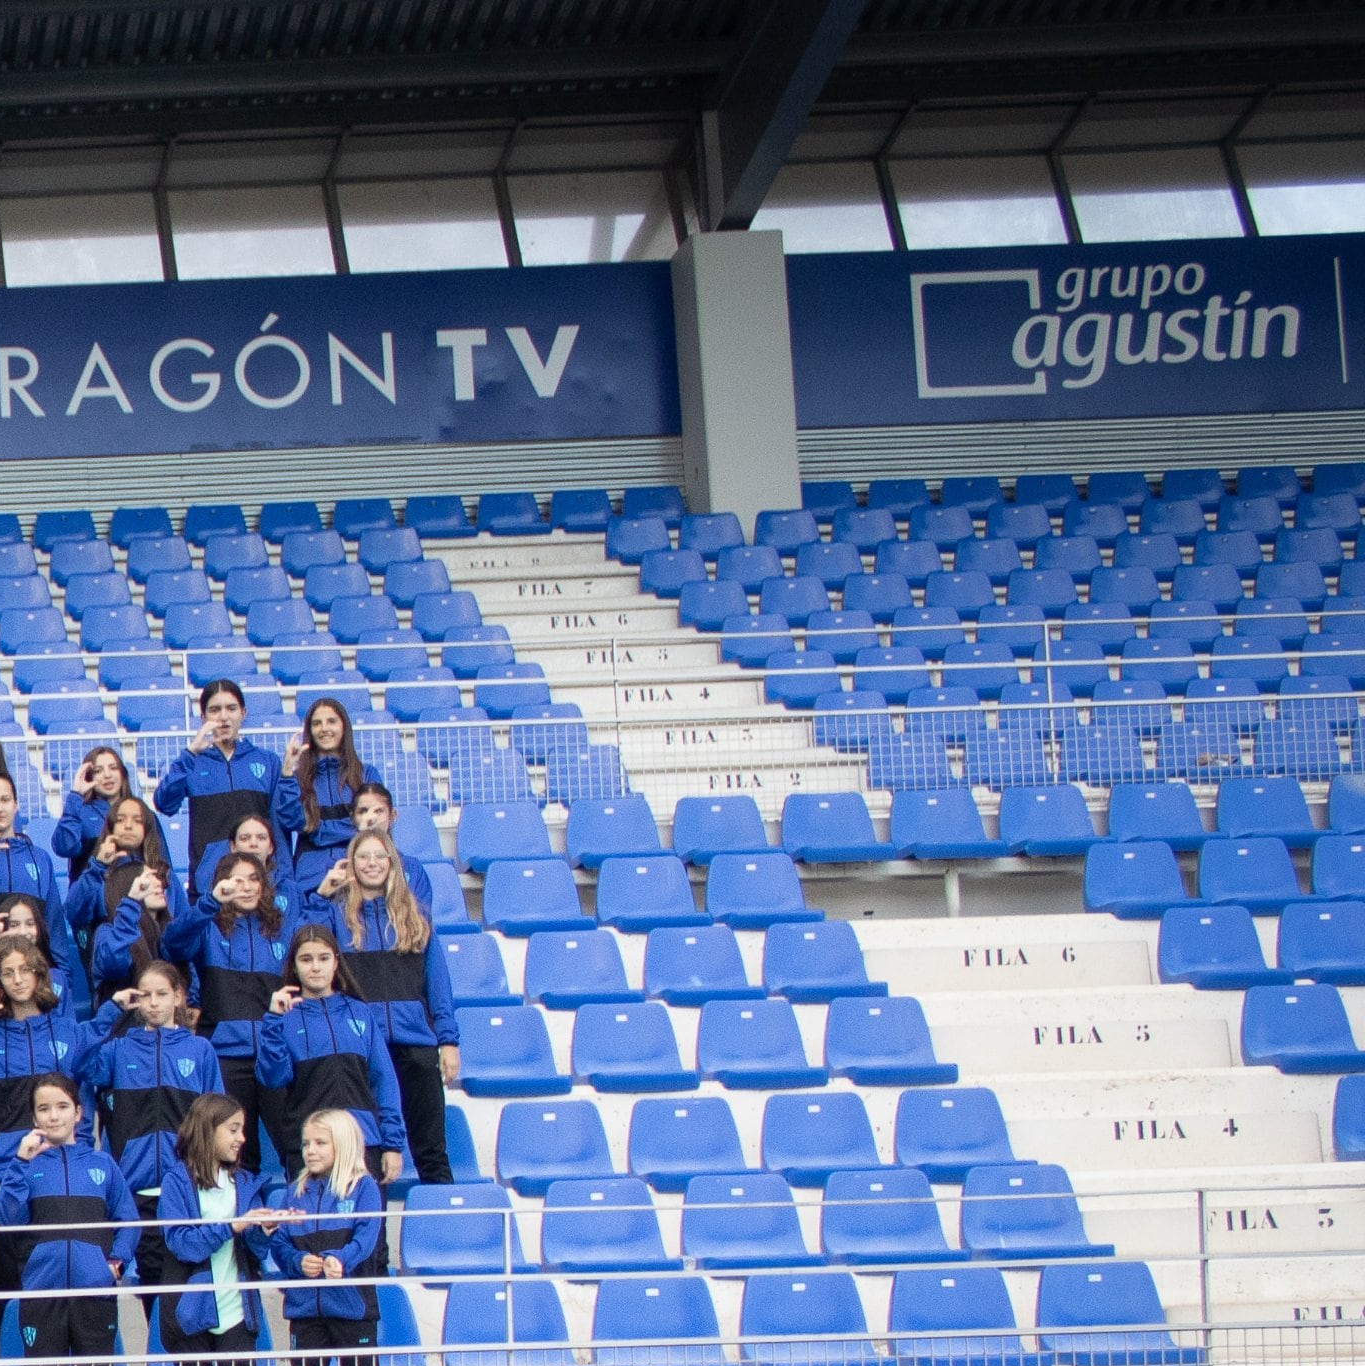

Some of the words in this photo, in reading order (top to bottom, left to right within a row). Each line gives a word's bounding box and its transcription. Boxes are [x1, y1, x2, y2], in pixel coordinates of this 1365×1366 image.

[1056, 263, 1205, 312] grupo
[1012, 291, 1300, 389] agustín
[436, 324, 580, 402] TV
[519, 582, 563, 596] FILA
[583, 581, 594, 593] 7
[550, 614, 596, 629] FILA
[618, 613, 628, 625] 6
[624, 687, 673, 702] FILA
[699, 687, 710, 700] 4
[665, 730, 717, 745] FILA
[709, 773, 762, 789] FILA
[789, 772, 801, 786] 2
[964, 948, 1029, 967] FILA
[1061, 947, 1076, 963] 6
[1034, 1025, 1104, 1045] FILA
[1136, 1024, 1151, 1042] 5
[1114, 1119, 1186, 1140] FILA
[1223, 1118, 1239, 1137] 4
